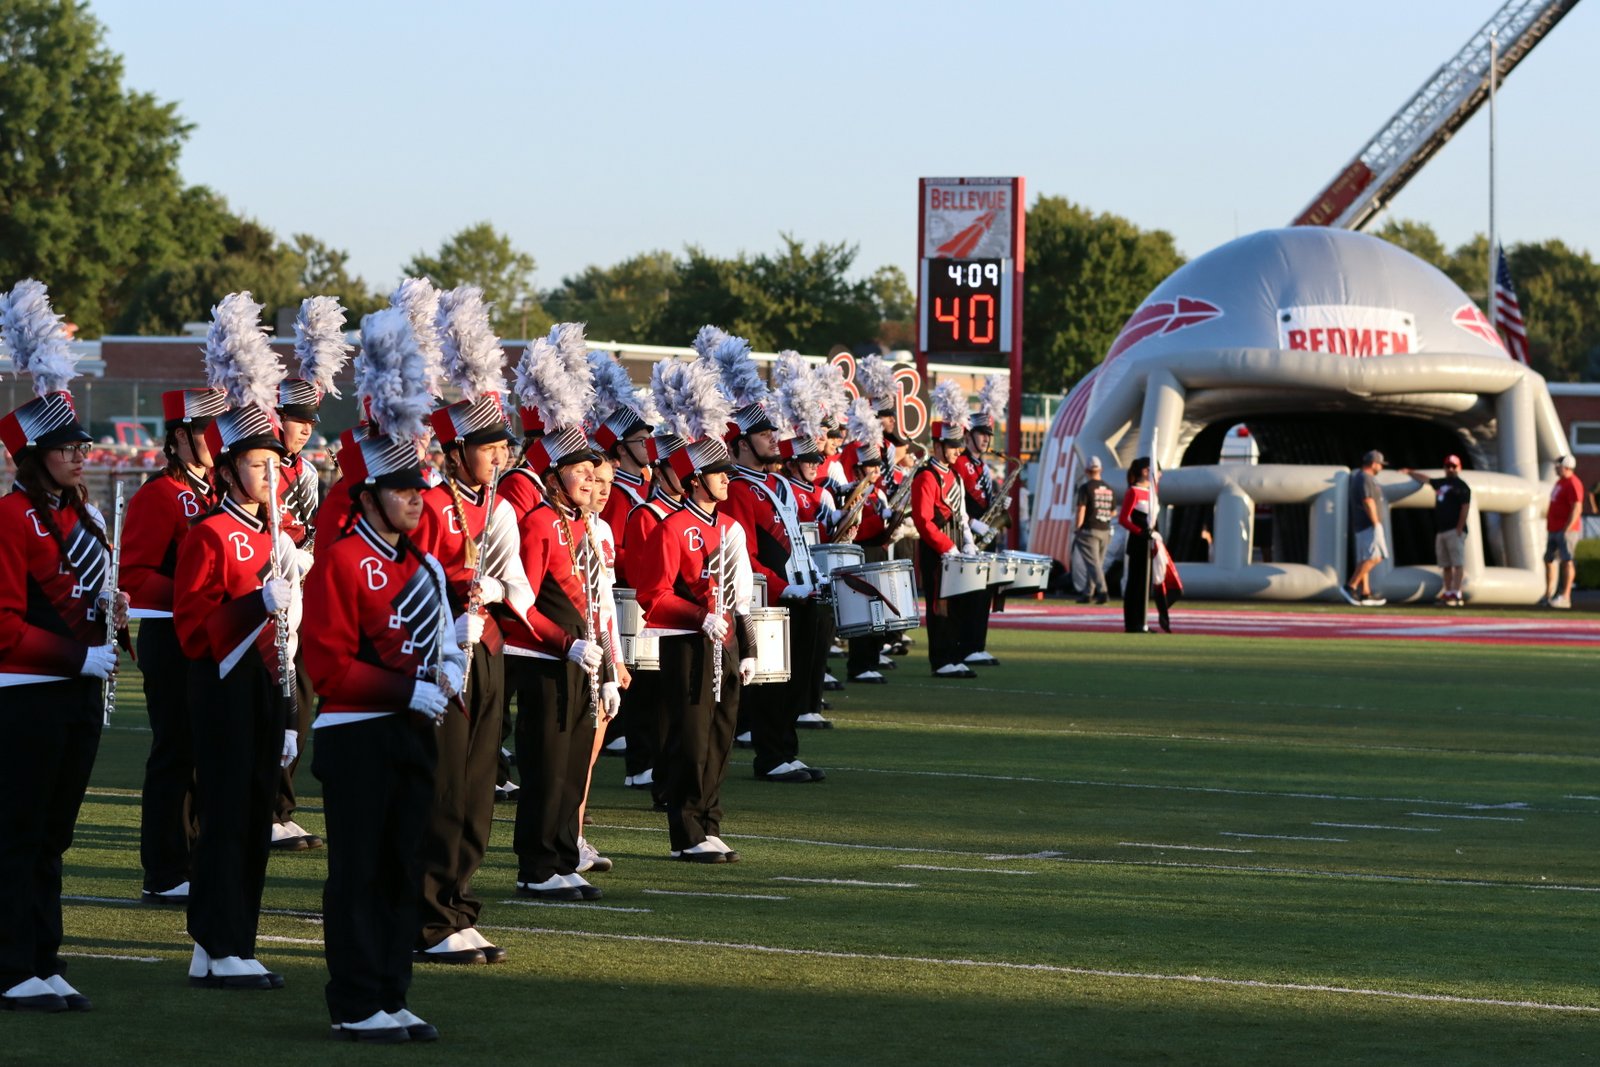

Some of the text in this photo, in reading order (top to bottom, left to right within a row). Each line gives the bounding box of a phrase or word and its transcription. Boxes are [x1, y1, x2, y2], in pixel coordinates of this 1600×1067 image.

[931, 188, 1006, 210] BELLEVUE
[948, 263, 998, 288] 4:09
[935, 294, 994, 344] 40
[1288, 328, 1408, 358] REDMEN
[894, 368, 927, 439] B
[177, 491, 200, 517] B
[228, 531, 254, 561] B
[684, 526, 703, 552] B
[359, 557, 388, 590] B
